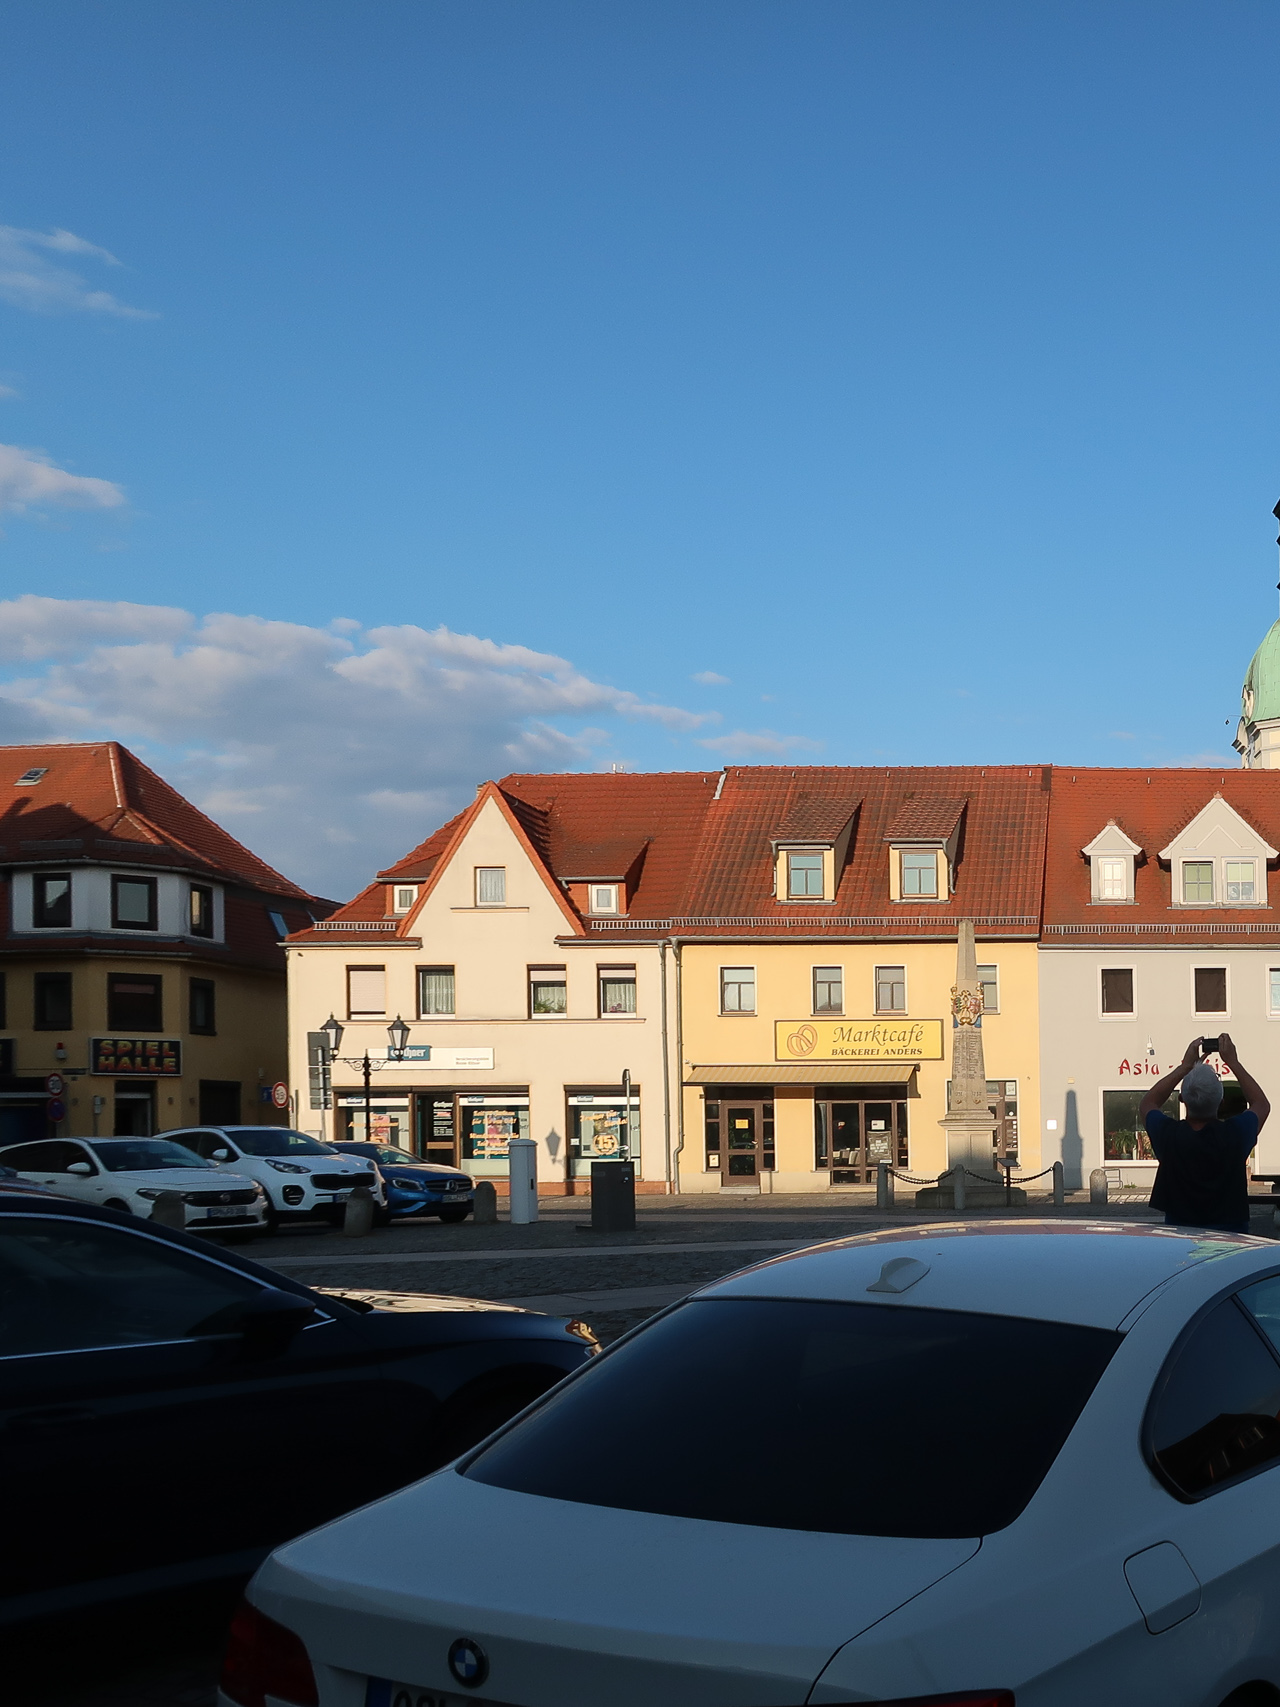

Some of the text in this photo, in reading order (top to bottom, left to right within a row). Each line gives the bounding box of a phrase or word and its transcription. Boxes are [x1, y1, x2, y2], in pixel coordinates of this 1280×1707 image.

[832, 1024, 924, 1048] Marktcafé
[100, 1040, 175, 1057] SPIEL
[831, 1047, 923, 1056] BÄCKEREI ANDERS
[98, 1056, 177, 1072] HALLE
[1118, 1058, 1160, 1076] Asia
[597, 1136, 613, 1149] 15
